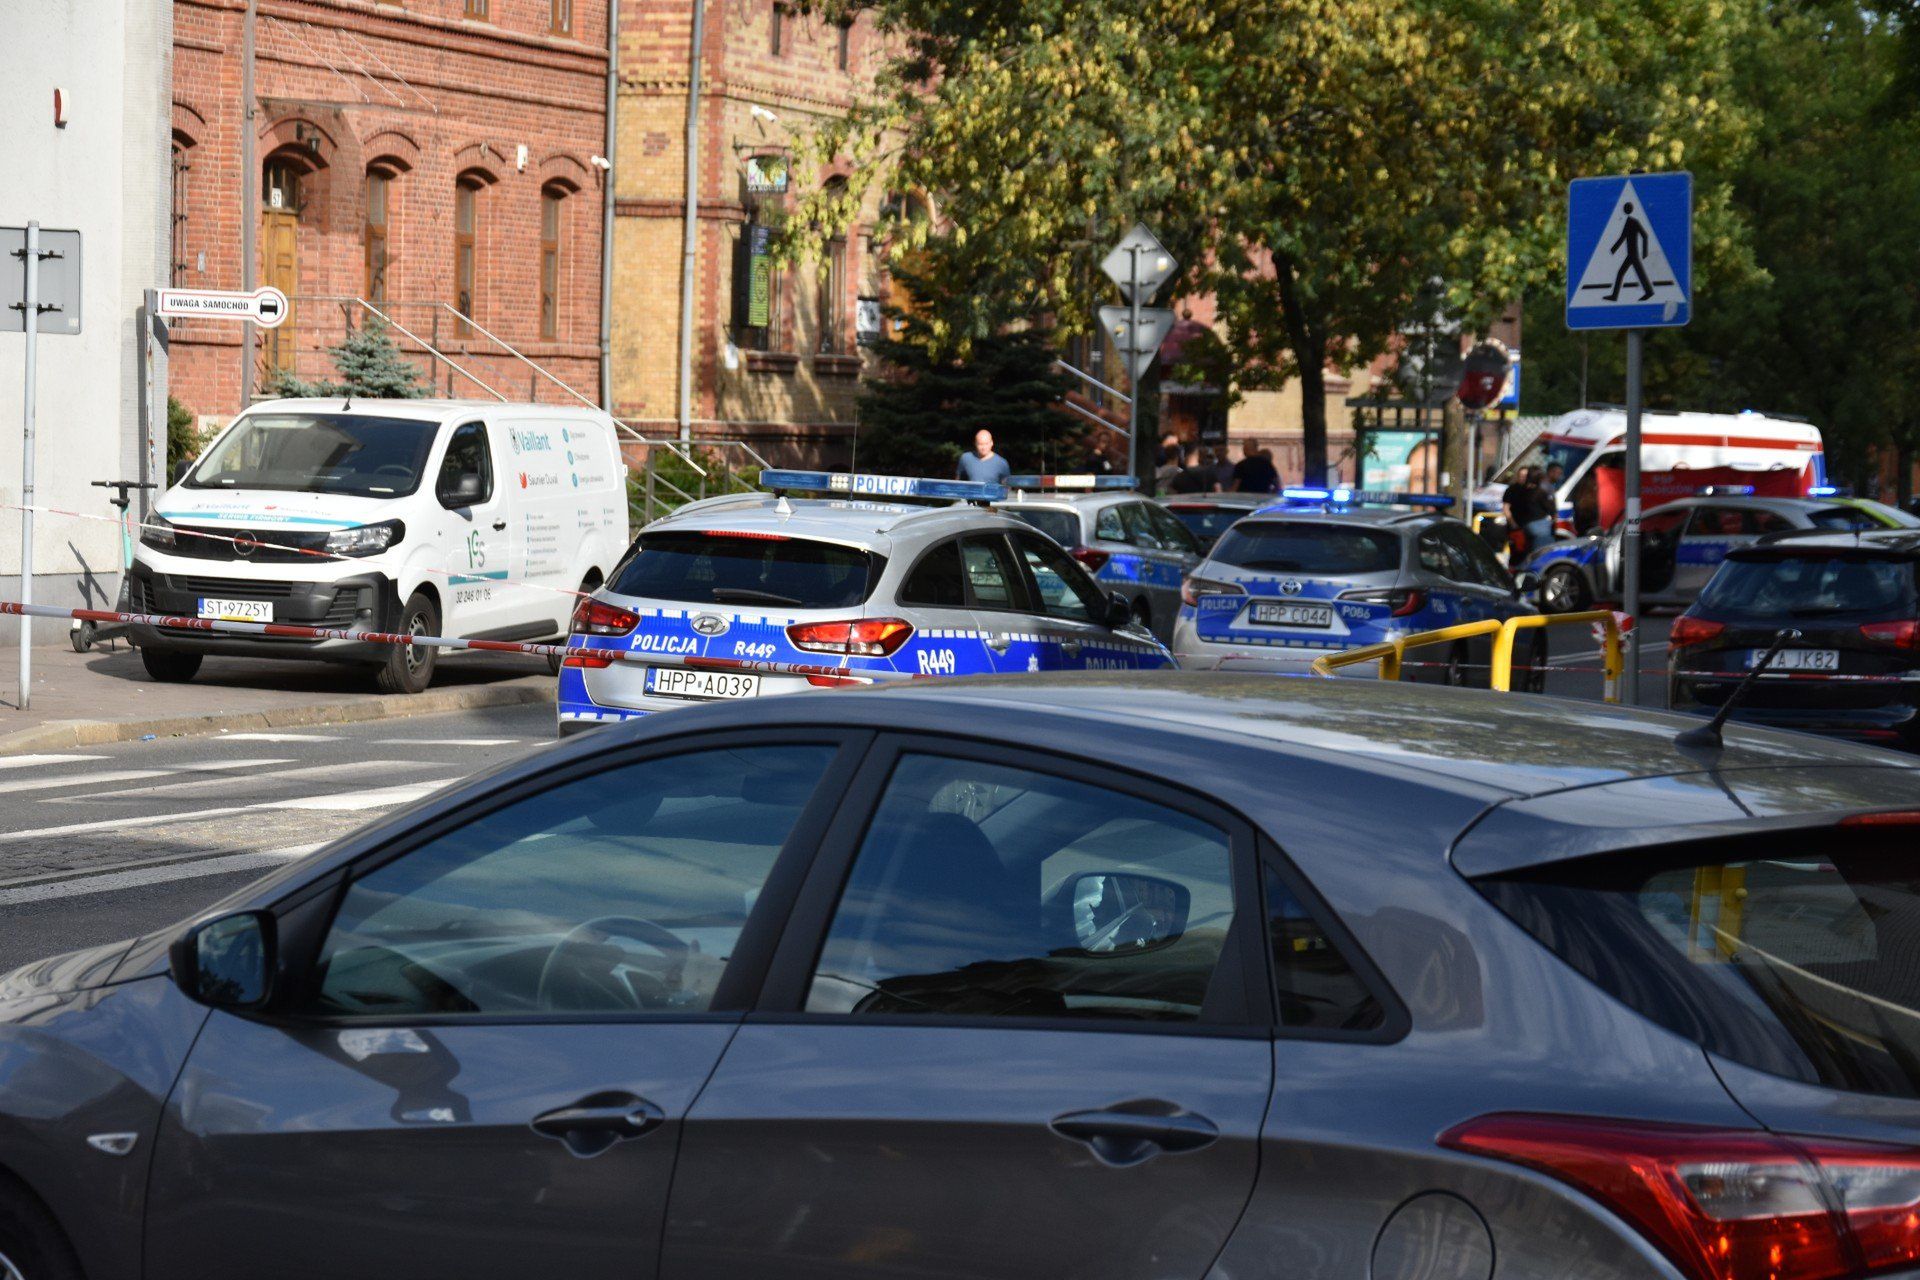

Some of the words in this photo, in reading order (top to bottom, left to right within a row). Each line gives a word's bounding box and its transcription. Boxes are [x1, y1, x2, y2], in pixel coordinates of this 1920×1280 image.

[170, 298, 200, 308] UWAGA
[202, 299, 249, 310] SAMOCHÓD
[517, 430, 551, 451] Vaillant
[856, 477, 917, 494] POLICJA
[217, 512, 248, 521] SERWIS
[206, 601, 222, 614] ST
[228, 602, 269, 617] 9725Y
[1202, 599, 1239, 610] POLICJA
[1258, 604, 1286, 621] HPP
[1291, 606, 1329, 625] C044
[630, 634, 697, 654] POLICJA
[733, 641, 776, 659] R449
[917, 648, 955, 674] R449
[1757, 650, 1787, 668] SA
[659, 670, 697, 692] HPP
[703, 674, 753, 697] A039
